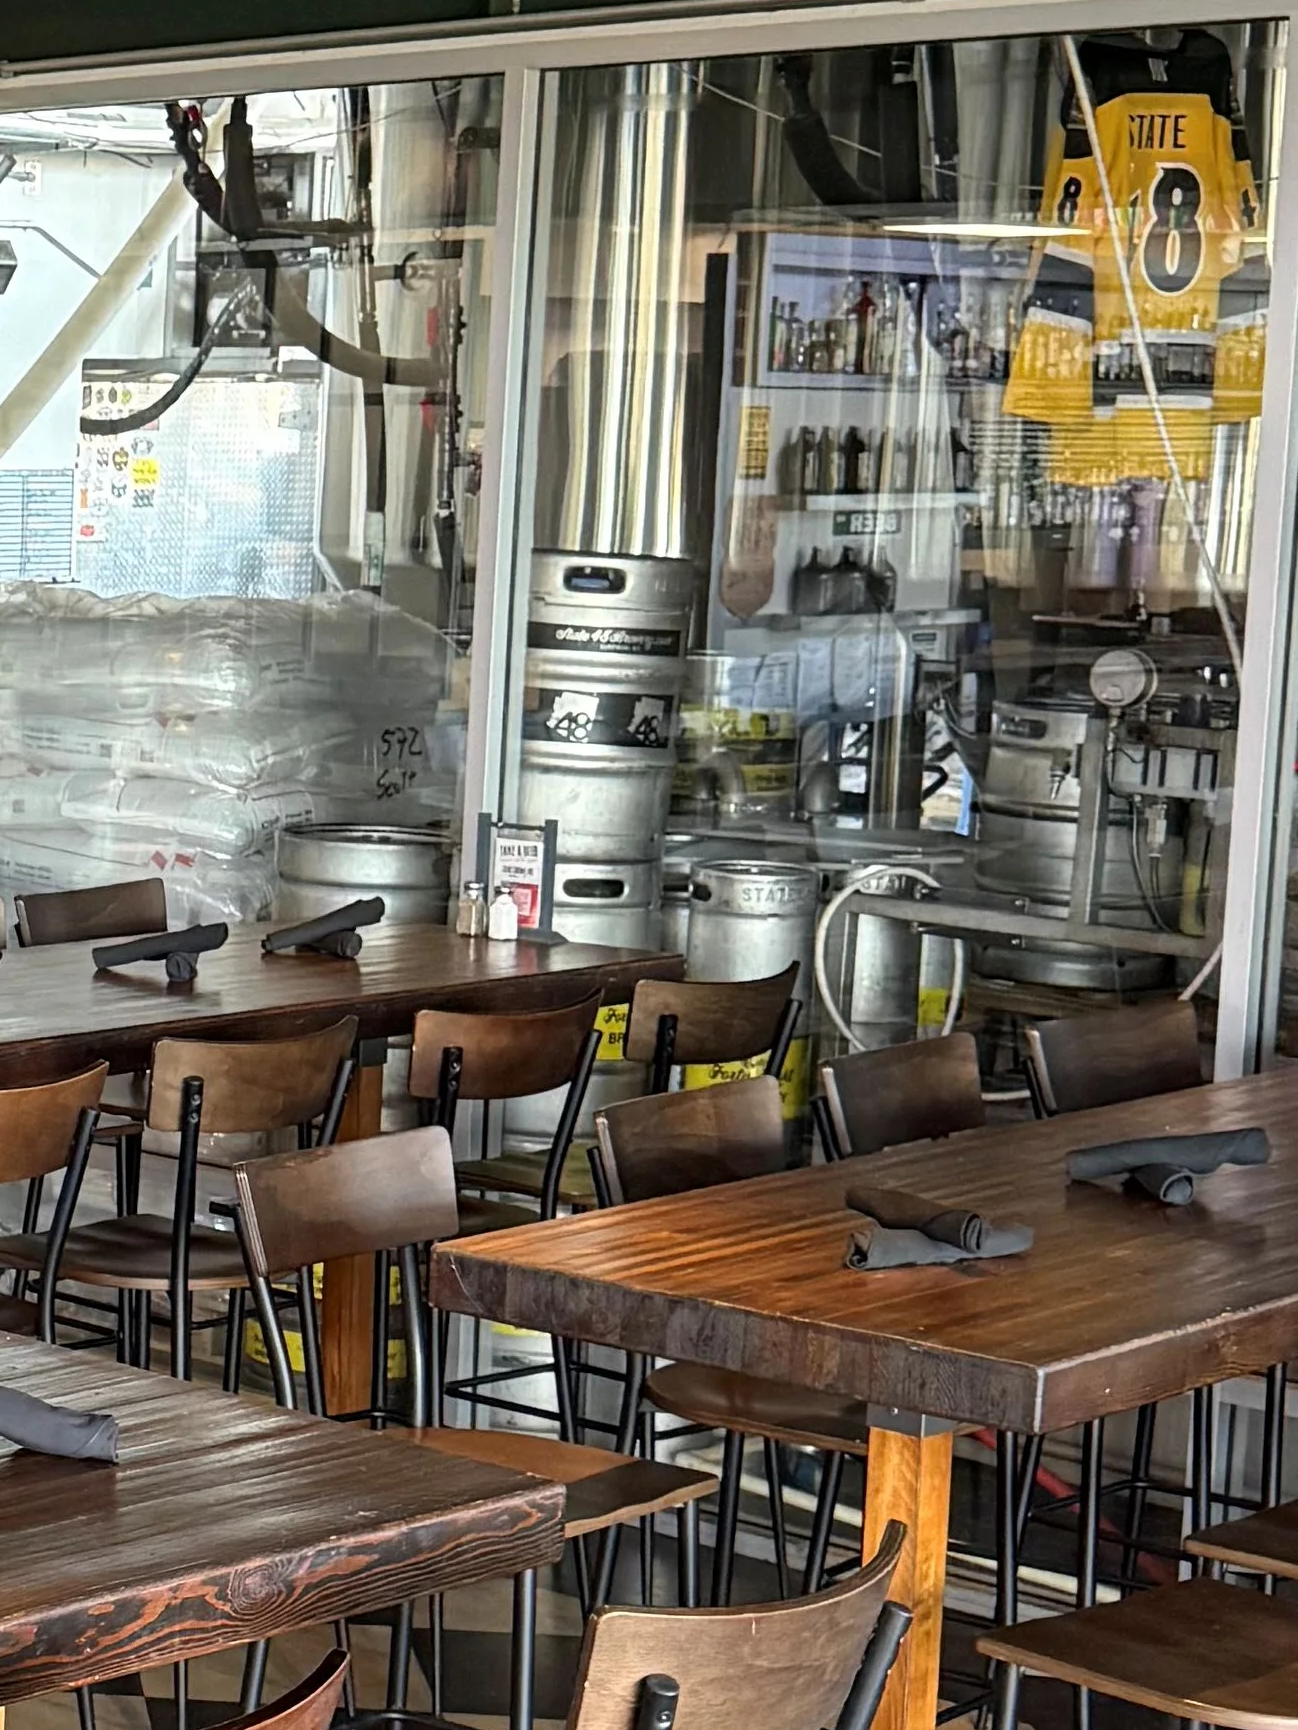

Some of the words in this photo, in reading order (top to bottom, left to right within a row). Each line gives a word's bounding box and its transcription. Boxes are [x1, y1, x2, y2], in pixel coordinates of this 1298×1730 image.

[1057, 175, 1083, 226] 8
[554, 711, 590, 739] 48
[633, 715, 658, 743] 48
